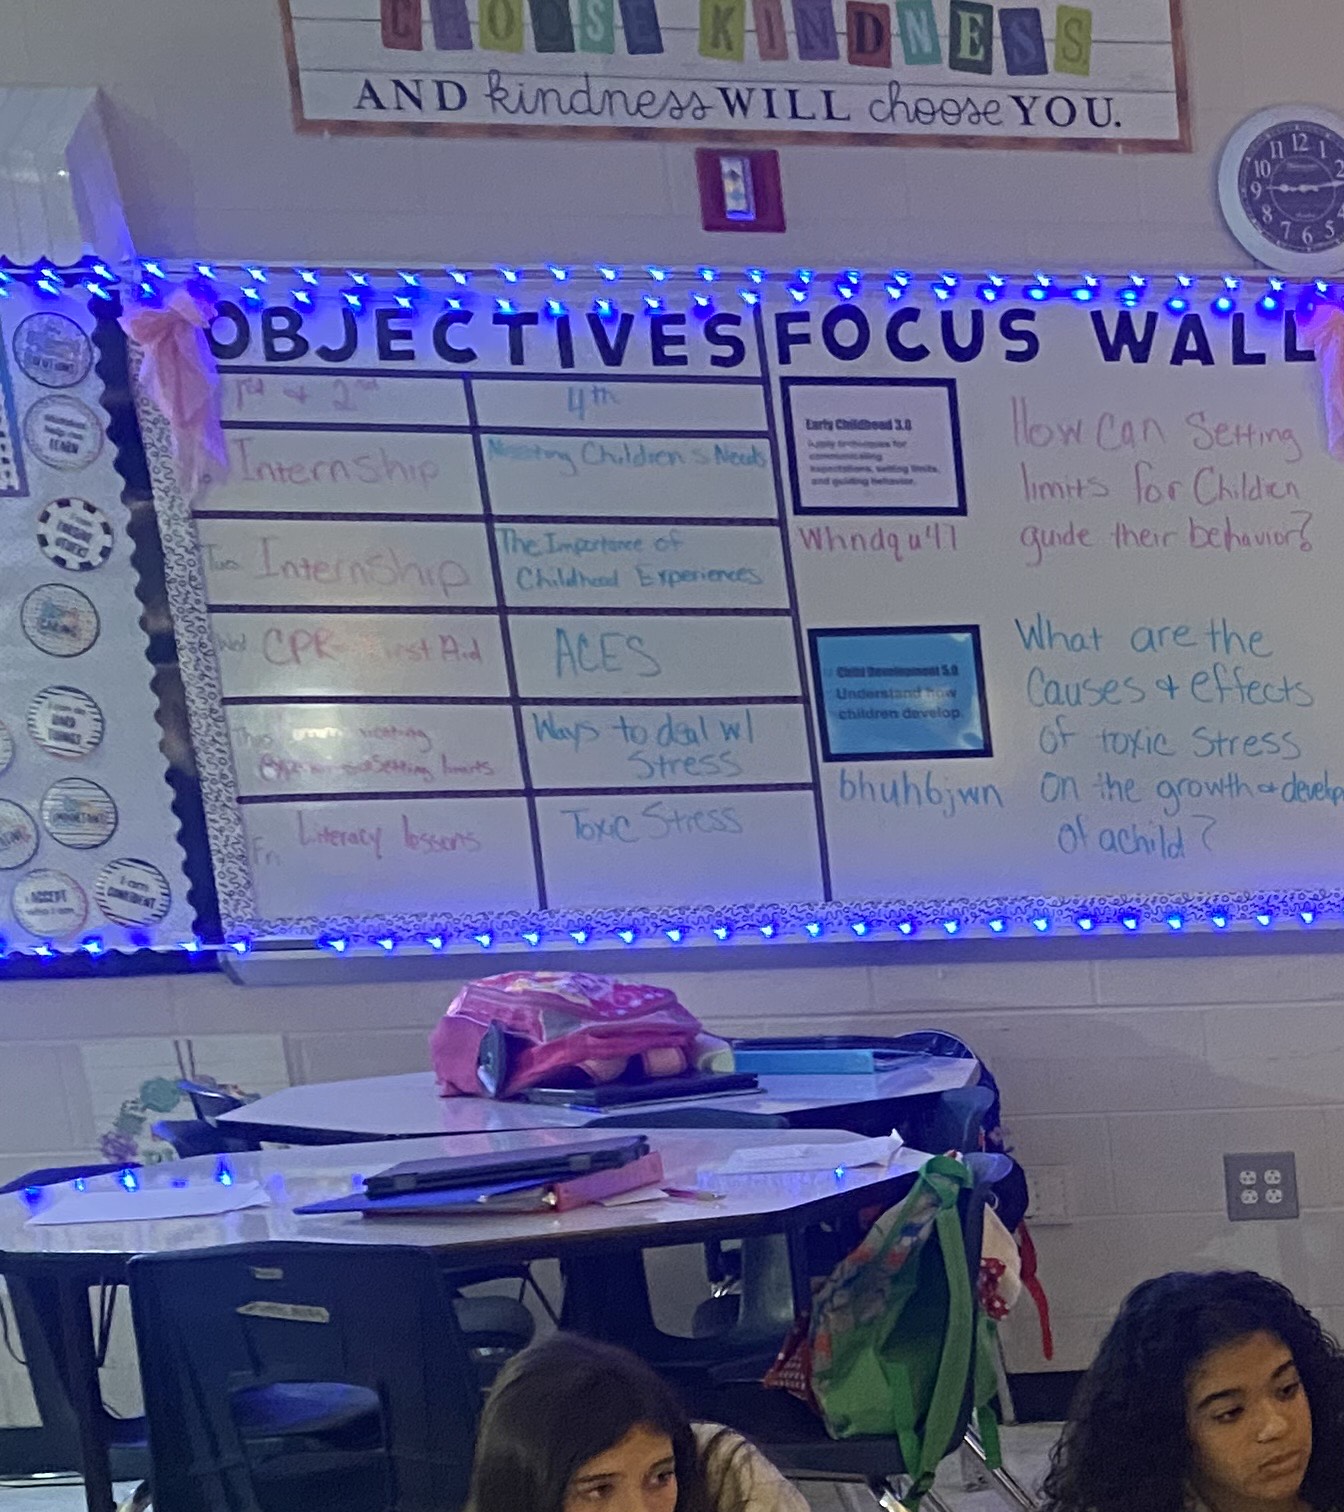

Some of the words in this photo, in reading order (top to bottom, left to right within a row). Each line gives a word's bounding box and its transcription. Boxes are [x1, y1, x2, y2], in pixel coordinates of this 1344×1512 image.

[709, 3, 1085, 64] KINDNESS
[353, 78, 468, 112] AND
[484, 69, 713, 120] kindness
[716, 86, 851, 121] WILL
[869, 79, 1003, 126] choose
[1010, 94, 1122, 128] YOU.
[1270, 140, 1284, 159] 11
[1292, 133, 1309, 151] 12
[1319, 140, 1327, 159] 1
[1254, 160, 1271, 178] 10
[1250, 181, 1262, 200] 9
[1262, 204, 1273, 224] 8
[1280, 220, 1291, 240] 7
[1325, 219, 1335, 238] 5
[1302, 226, 1313, 245] 6
[205, 300, 746, 369] OBJECTIVES
[777, 303, 1040, 366] FOCUS
[1090, 309, 1317, 367] WALL
[567, 385, 620, 421] 4th
[1011, 395, 1082, 448] How
[231, 436, 441, 490] Internship
[1021, 461, 1110, 504] limits
[1134, 459, 1184, 505] for
[496, 526, 542, 557] The
[653, 527, 684, 552] of
[1020, 520, 1094, 568] guide
[1111, 521, 1178, 549] their
[1188, 510, 1313, 552] behavior?
[253, 533, 471, 599] Internship
[554, 626, 663, 679] ACES
[1013, 611, 1103, 653] What
[1130, 621, 1198, 654] are
[1207, 617, 1274, 658] the
[532, 710, 600, 752] Ways
[613, 714, 648, 746] to
[656, 711, 709, 748] deal
[838, 708, 899, 721] children
[902, 705, 960, 721] develop
[1098, 726, 1176, 758] toxic
[1093, 772, 1142, 802] the
[1156, 771, 1252, 817] growth
[559, 807, 640, 843] Toxic
